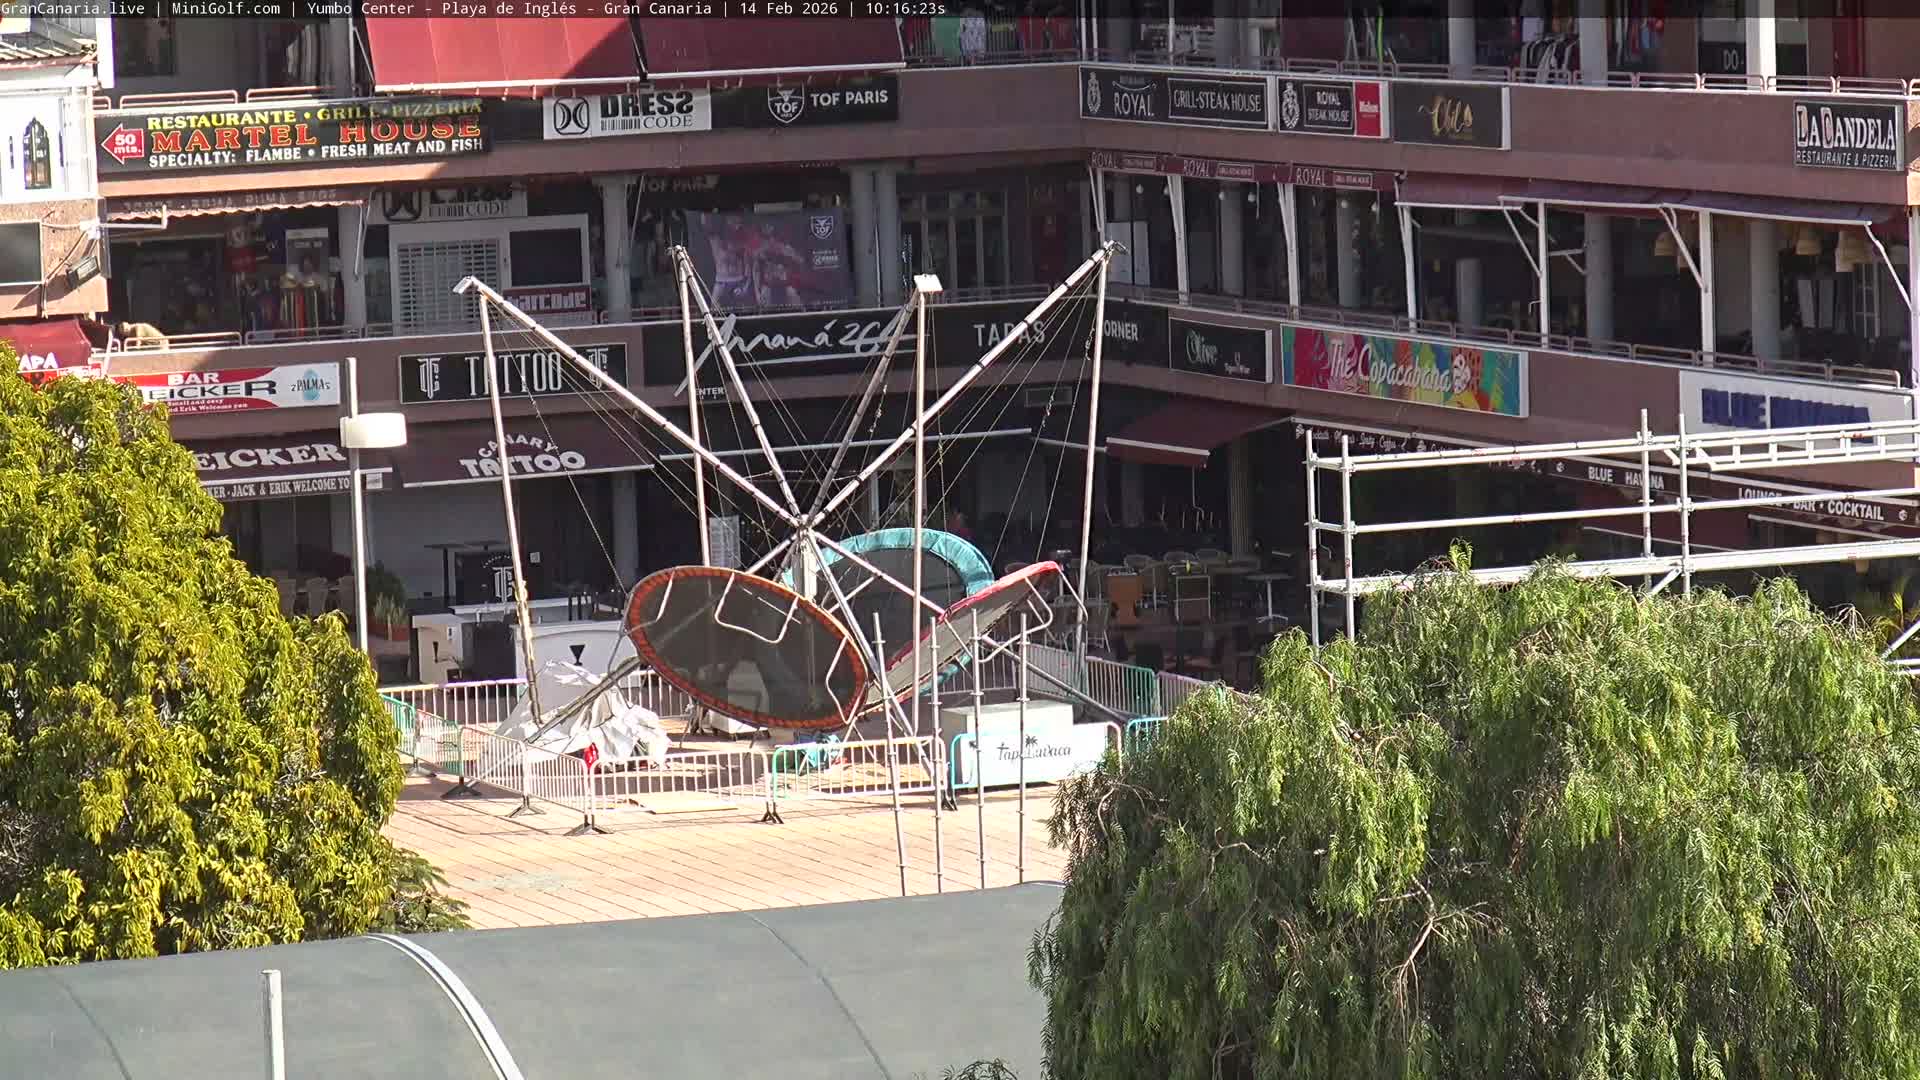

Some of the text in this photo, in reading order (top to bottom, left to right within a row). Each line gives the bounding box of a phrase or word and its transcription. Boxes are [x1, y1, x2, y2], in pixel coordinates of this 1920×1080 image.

[600, 91, 694, 118] DRESS
[774, 101, 799, 114] TOF
[810, 90, 889, 107] TOF PARIS
[1114, 92, 1155, 117] ROYAL
[1231, 95, 1262, 112] HOUSE
[1316, 91, 1341, 106] ROYAL
[147, 99, 482, 130] RESTAURANTE GRILL PIZZERIA
[643, 115, 693, 129] CODE
[1307, 108, 1350, 122] STEAK HOUSE
[115, 134, 136, 146] 50
[151, 116, 481, 154] MARTEL HOUSE
[114, 146, 142, 154] mts.
[149, 138, 483, 168] SPECIALTY: FLAMBE FRESH MEAT AND FISH
[1796, 150, 1852, 166] RESTAURANTE
[1862, 154, 1897, 168] PIZZERIA
[1183, 160, 1209, 177] ROYAL
[1296, 168, 1326, 186] ROYAL
[1103, 320, 1139, 341] ORNER
[18, 352, 59, 371] APA
[1330, 339, 1453, 393] The Copacabana
[168, 372, 220, 386] BAR
[149, 380, 277, 400] EICKER
[478, 434, 559, 457] CANARY
[193, 443, 347, 471] EICKER
[459, 450, 586, 477] TATTOO
[206, 477, 350, 499] KER JACK & ERIK WELCOME YO
[1588, 466, 1665, 490] BLUE HAVNA
[1793, 499, 1817, 512] BAR
[1827, 500, 1884, 520] COCKTAIL
